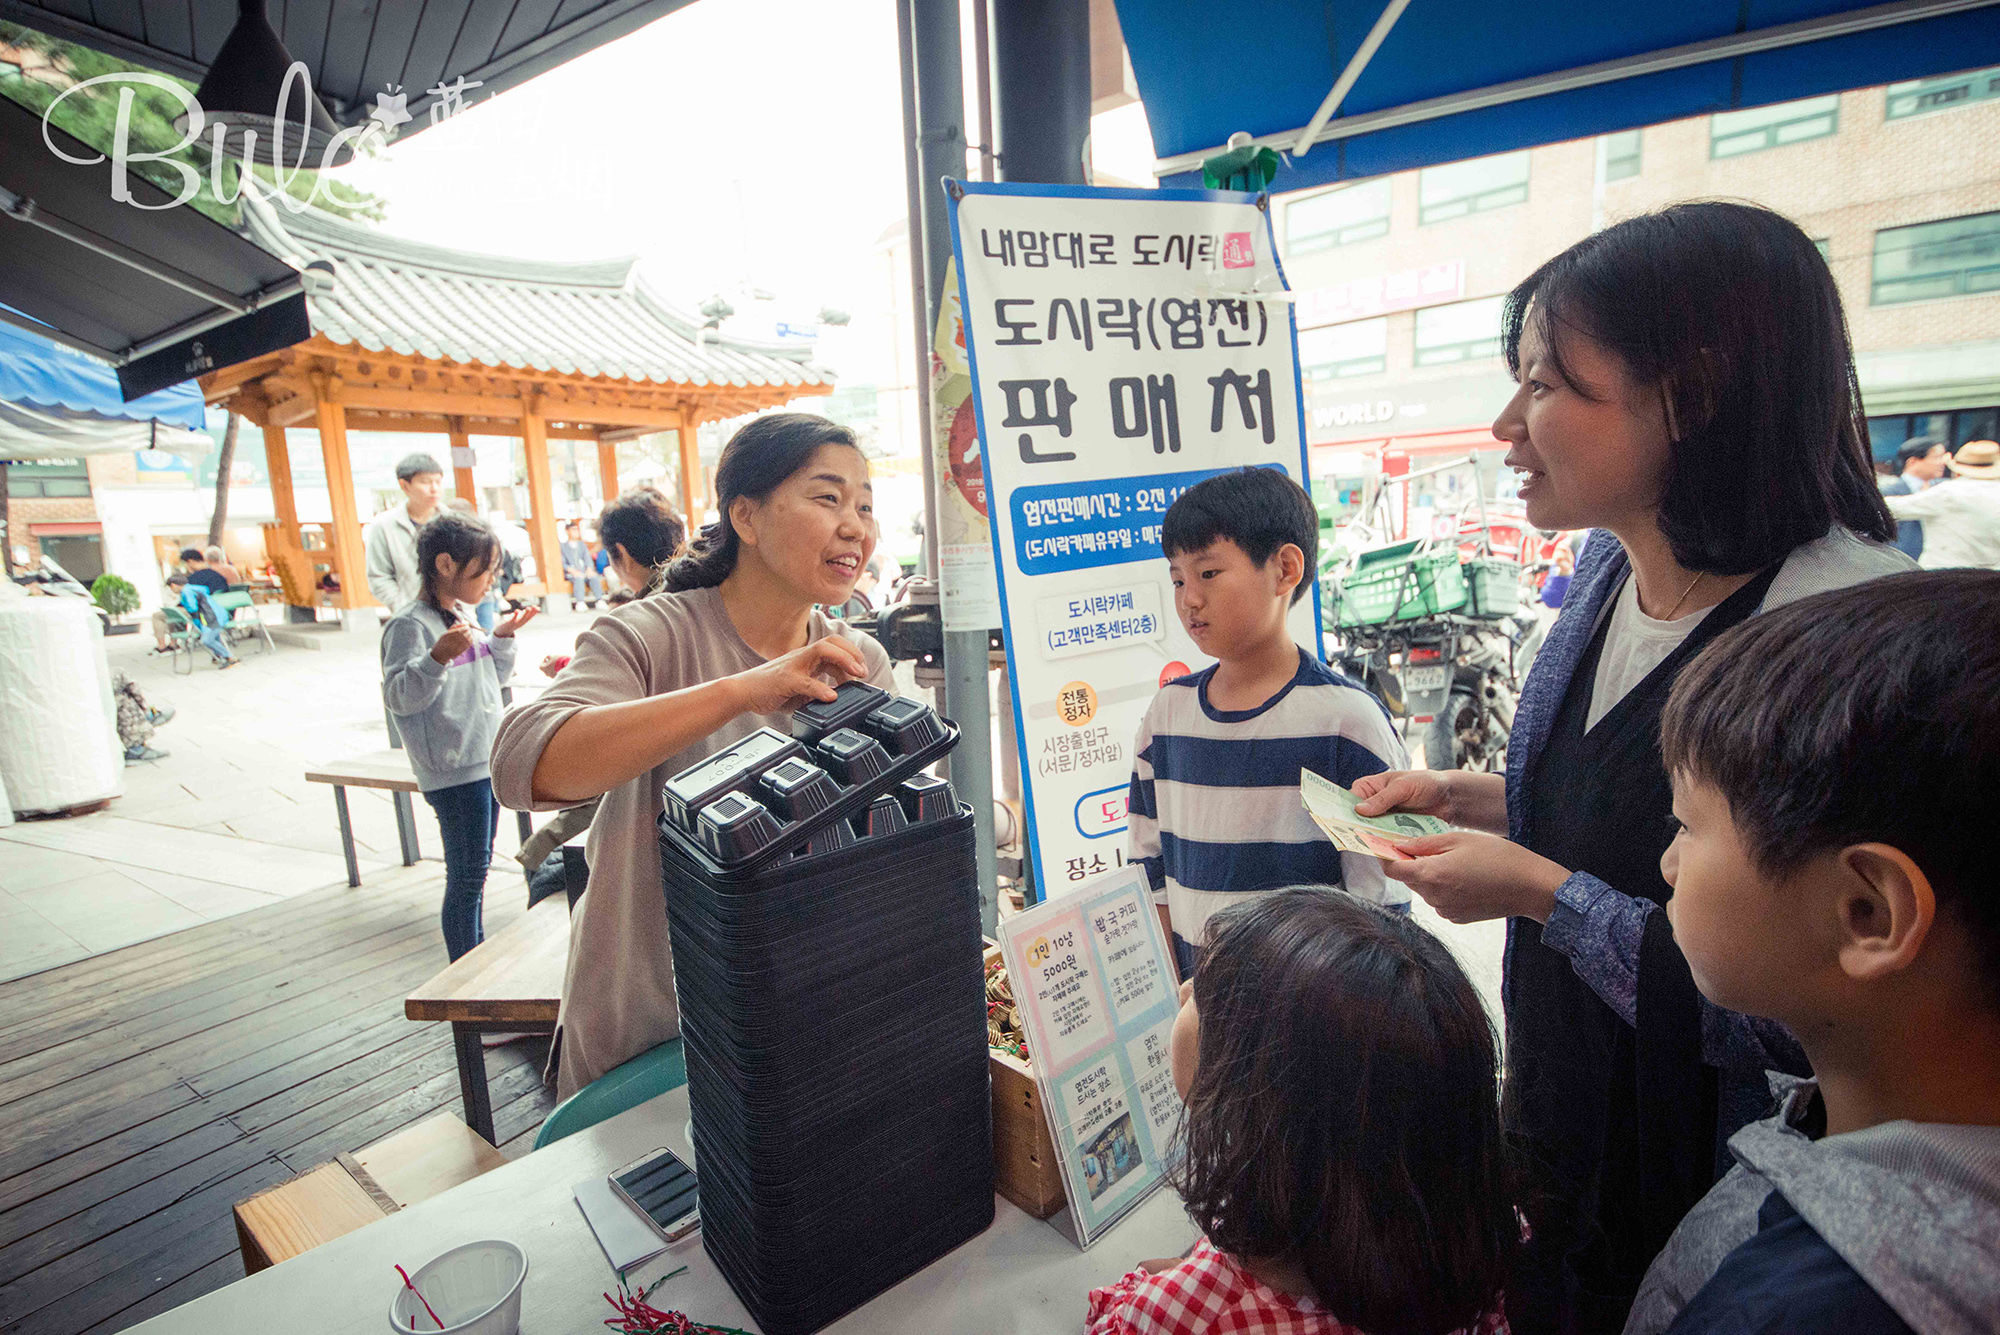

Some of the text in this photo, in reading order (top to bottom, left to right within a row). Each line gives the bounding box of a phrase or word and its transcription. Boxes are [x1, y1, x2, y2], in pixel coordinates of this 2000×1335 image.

[981, 228, 1219, 270] 내맘대로 도시락
[995, 297, 1267, 351] 도시락(엽전)
[1313, 399, 1395, 429] WORLD
[1023, 492, 1121, 527] 엽전판매시간
[1136, 487, 1166, 512] 오전
[1025, 528, 1132, 560] (도시락카페휴무일
[1068, 591, 1134, 618] 도시락카페
[1048, 613, 1157, 651] (고객만족센터2층)
[1062, 688, 1088, 706] 전통
[1064, 704, 1091, 722] 정자
[1043, 726, 1109, 754] 시장출입구
[1038, 741, 1122, 778] (서문/정자앞)
[1065, 853, 1108, 881] 장소
[1052, 931, 1073, 950] 10냥
[1043, 954, 1078, 981] 5000원
[1075, 1066, 1107, 1093] 엽전도시락
[1077, 1077, 1111, 1105] 드시는 장소
